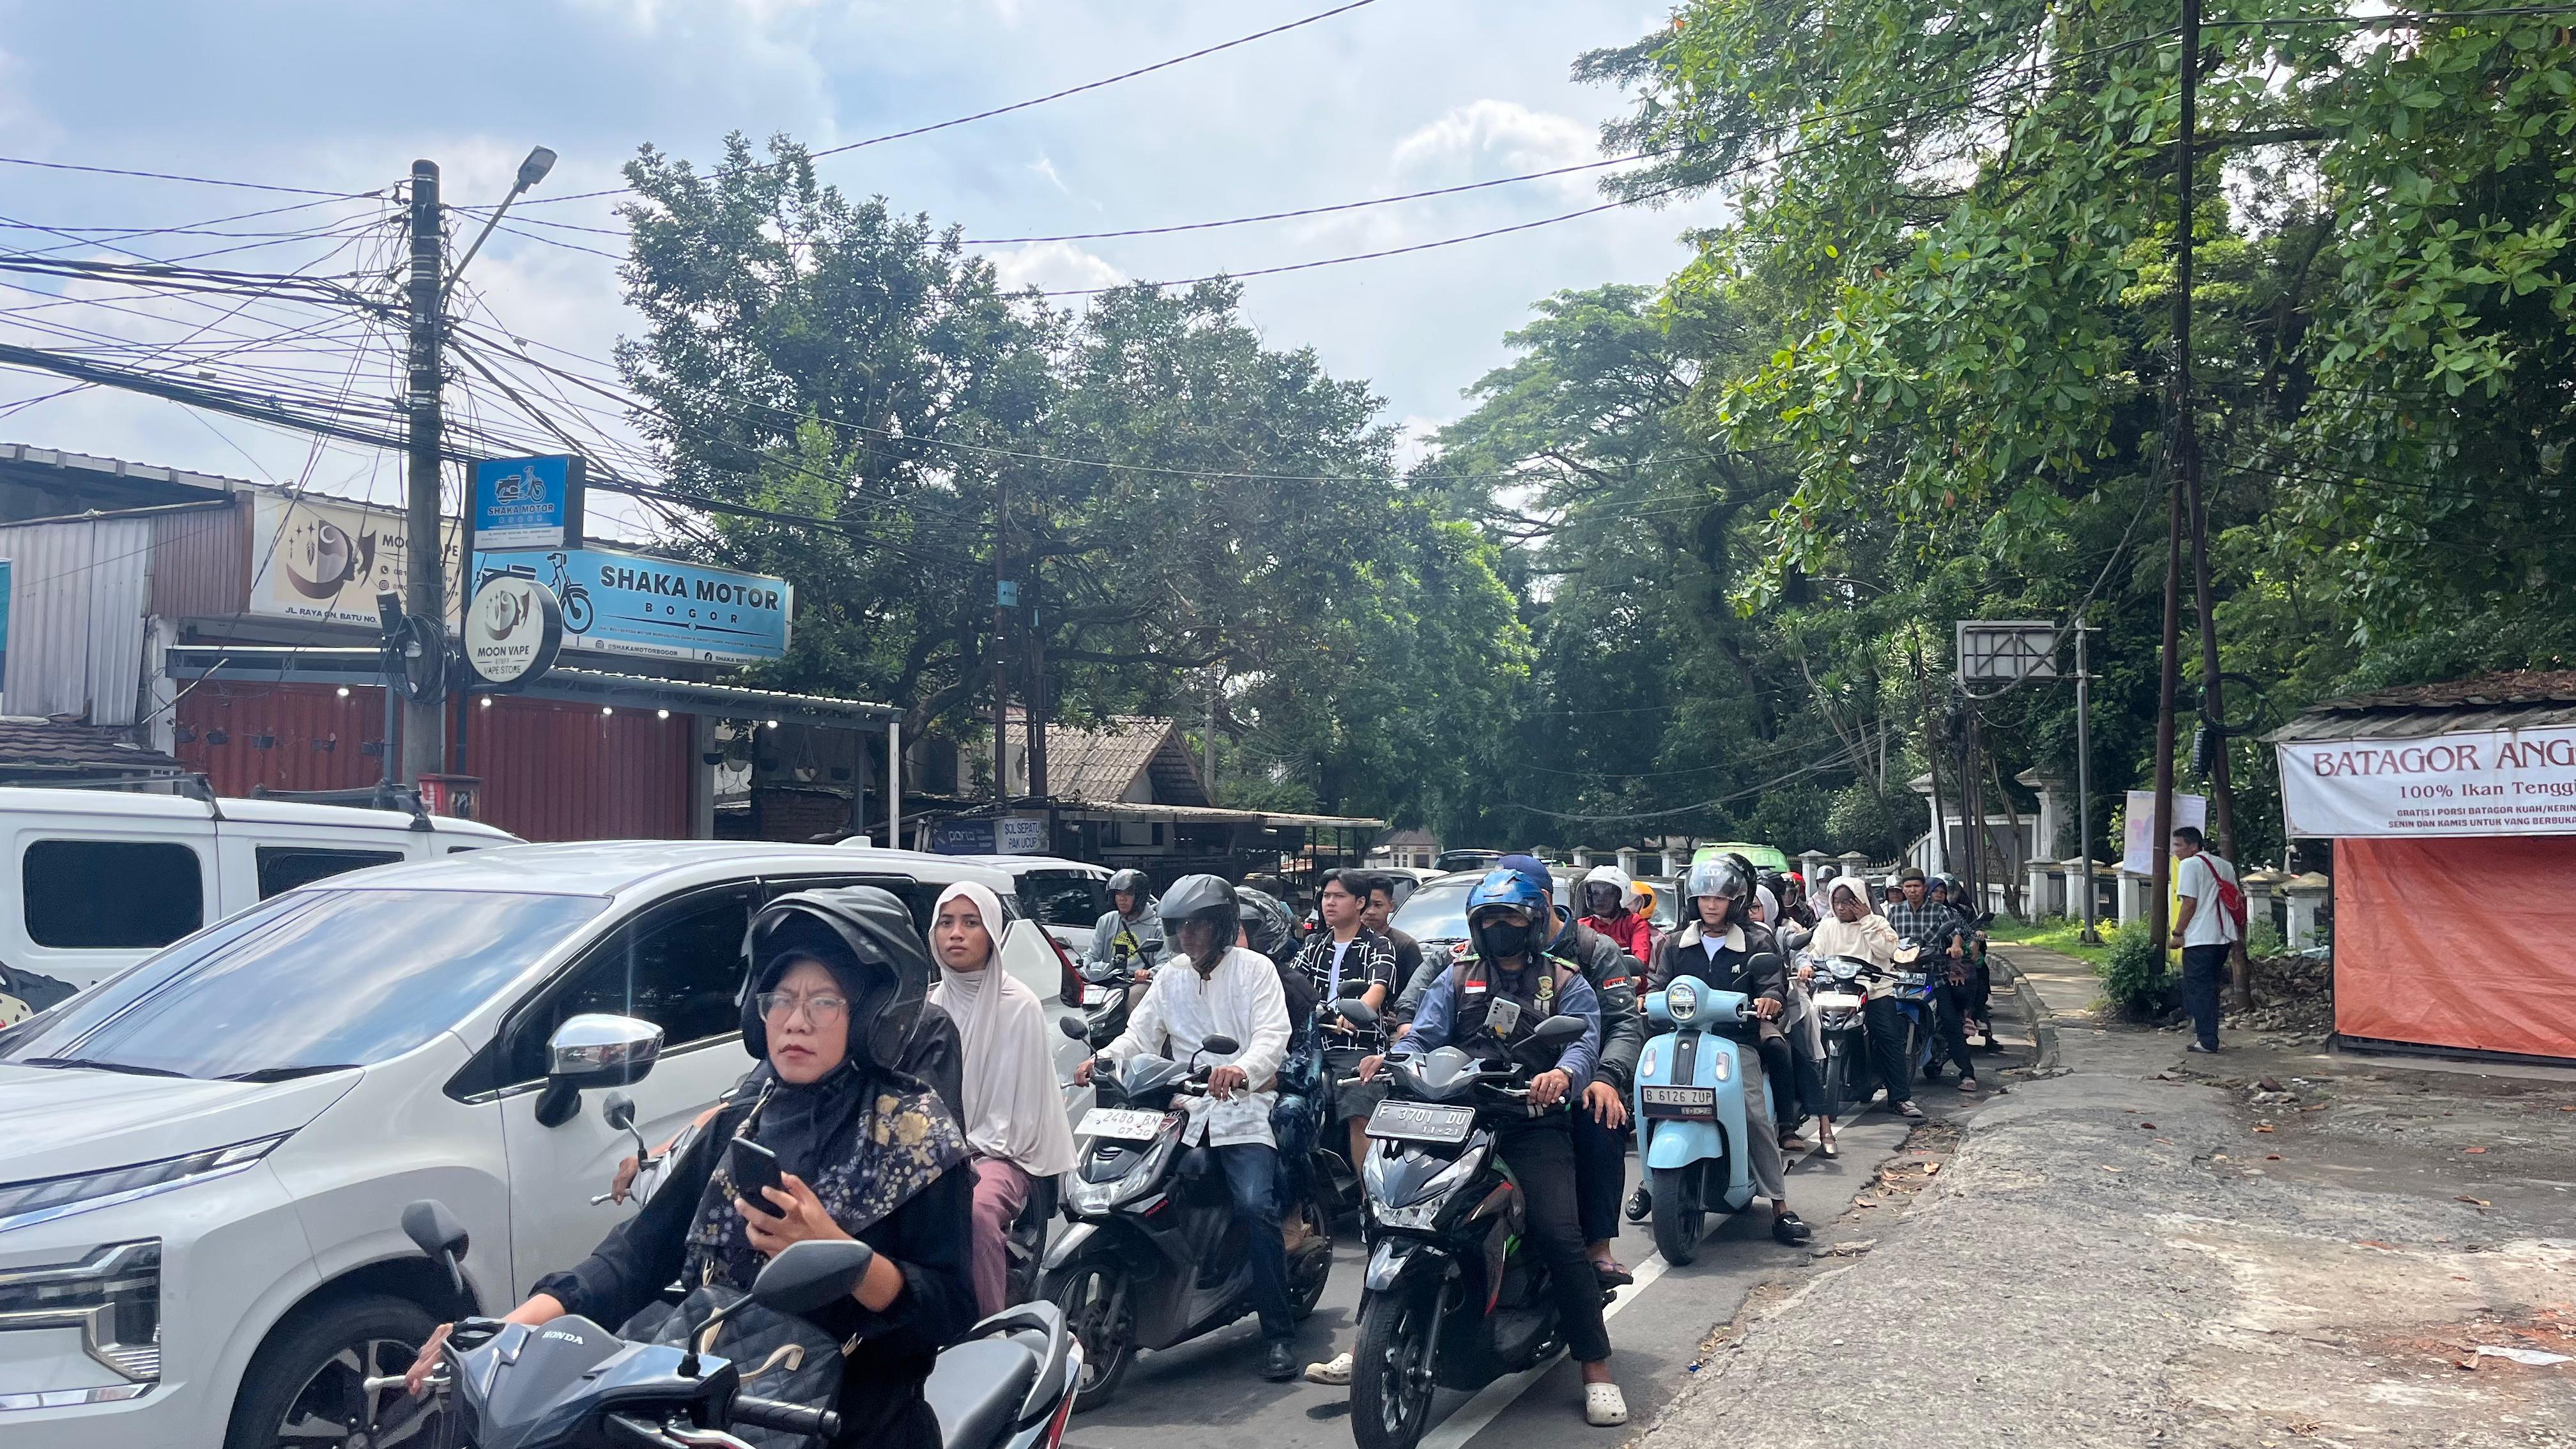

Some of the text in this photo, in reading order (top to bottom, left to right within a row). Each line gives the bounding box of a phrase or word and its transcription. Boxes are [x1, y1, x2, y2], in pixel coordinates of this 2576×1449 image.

[488, 504, 554, 515] SHAKA MOTOR
[601, 565, 778, 611] SHAKA MOTOR
[299, 608, 322, 617] RAYA
[340, 613, 362, 622] BATU
[645, 602, 738, 624] BOGOR
[477, 645, 530, 657] MOON VAPE
[484, 665, 521, 675] VAPE STORE
[2313, 744, 2481, 776] BATAGOR
[2401, 785, 2453, 799] 100%
[2462, 783, 2504, 797] Ikan
[2396, 809, 2430, 817] GRATIS
[2437, 807, 2466, 816] PORSI
[2469, 806, 2513, 815] BATAGOR
[1005, 822, 1041, 835] SOL SEPATU
[2388, 820, 2414, 829] SENIN
[2437, 819, 2467, 827] KAMIS
[2470, 818, 2502, 826] UNTUK
[2504, 817, 2531, 825] YANG
[1009, 837, 1036, 849] PAK UCUP
[1646, 1090, 1712, 1103] B 6126 ZUP
[1084, 1110, 1161, 1126] F 2486 BN
[1378, 1107, 1466, 1125] F 3701 DU
[542, 1330, 583, 1345] HONDA
